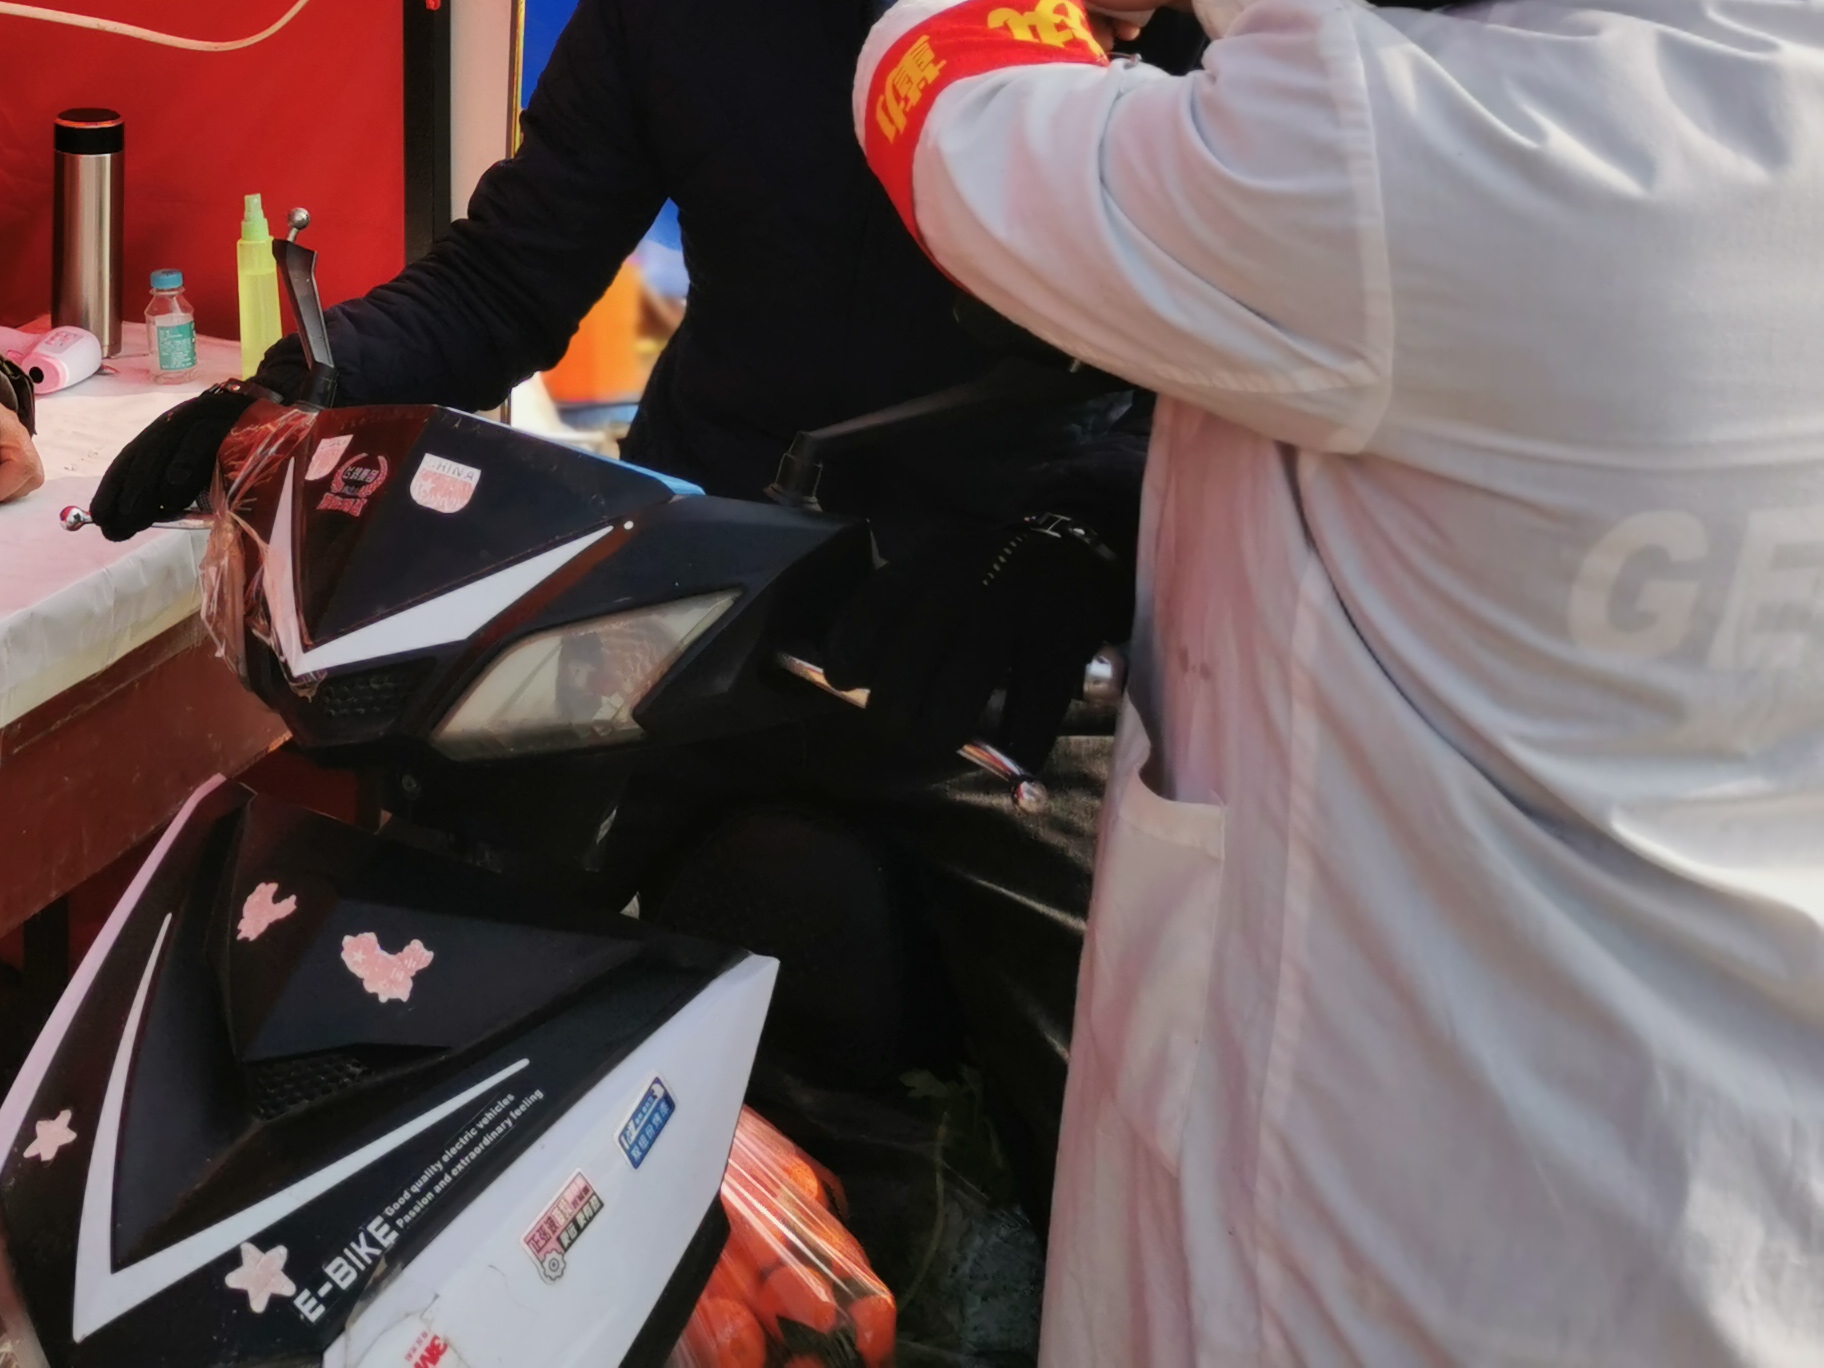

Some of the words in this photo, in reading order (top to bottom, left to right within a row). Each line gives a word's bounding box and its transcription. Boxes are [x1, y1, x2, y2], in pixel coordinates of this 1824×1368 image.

[384, 1189, 412, 1217] Good
[410, 1160, 443, 1194] quality
[441, 1127, 478, 1163] electric
[476, 1093, 515, 1129] vehicles
[395, 1190, 435, 1229] Passion
[432, 1172, 453, 1194] and
[450, 1117, 514, 1177] extraordinary
[509, 1088, 545, 1120] feeling
[293, 1215, 399, 1323] E-BIKE
